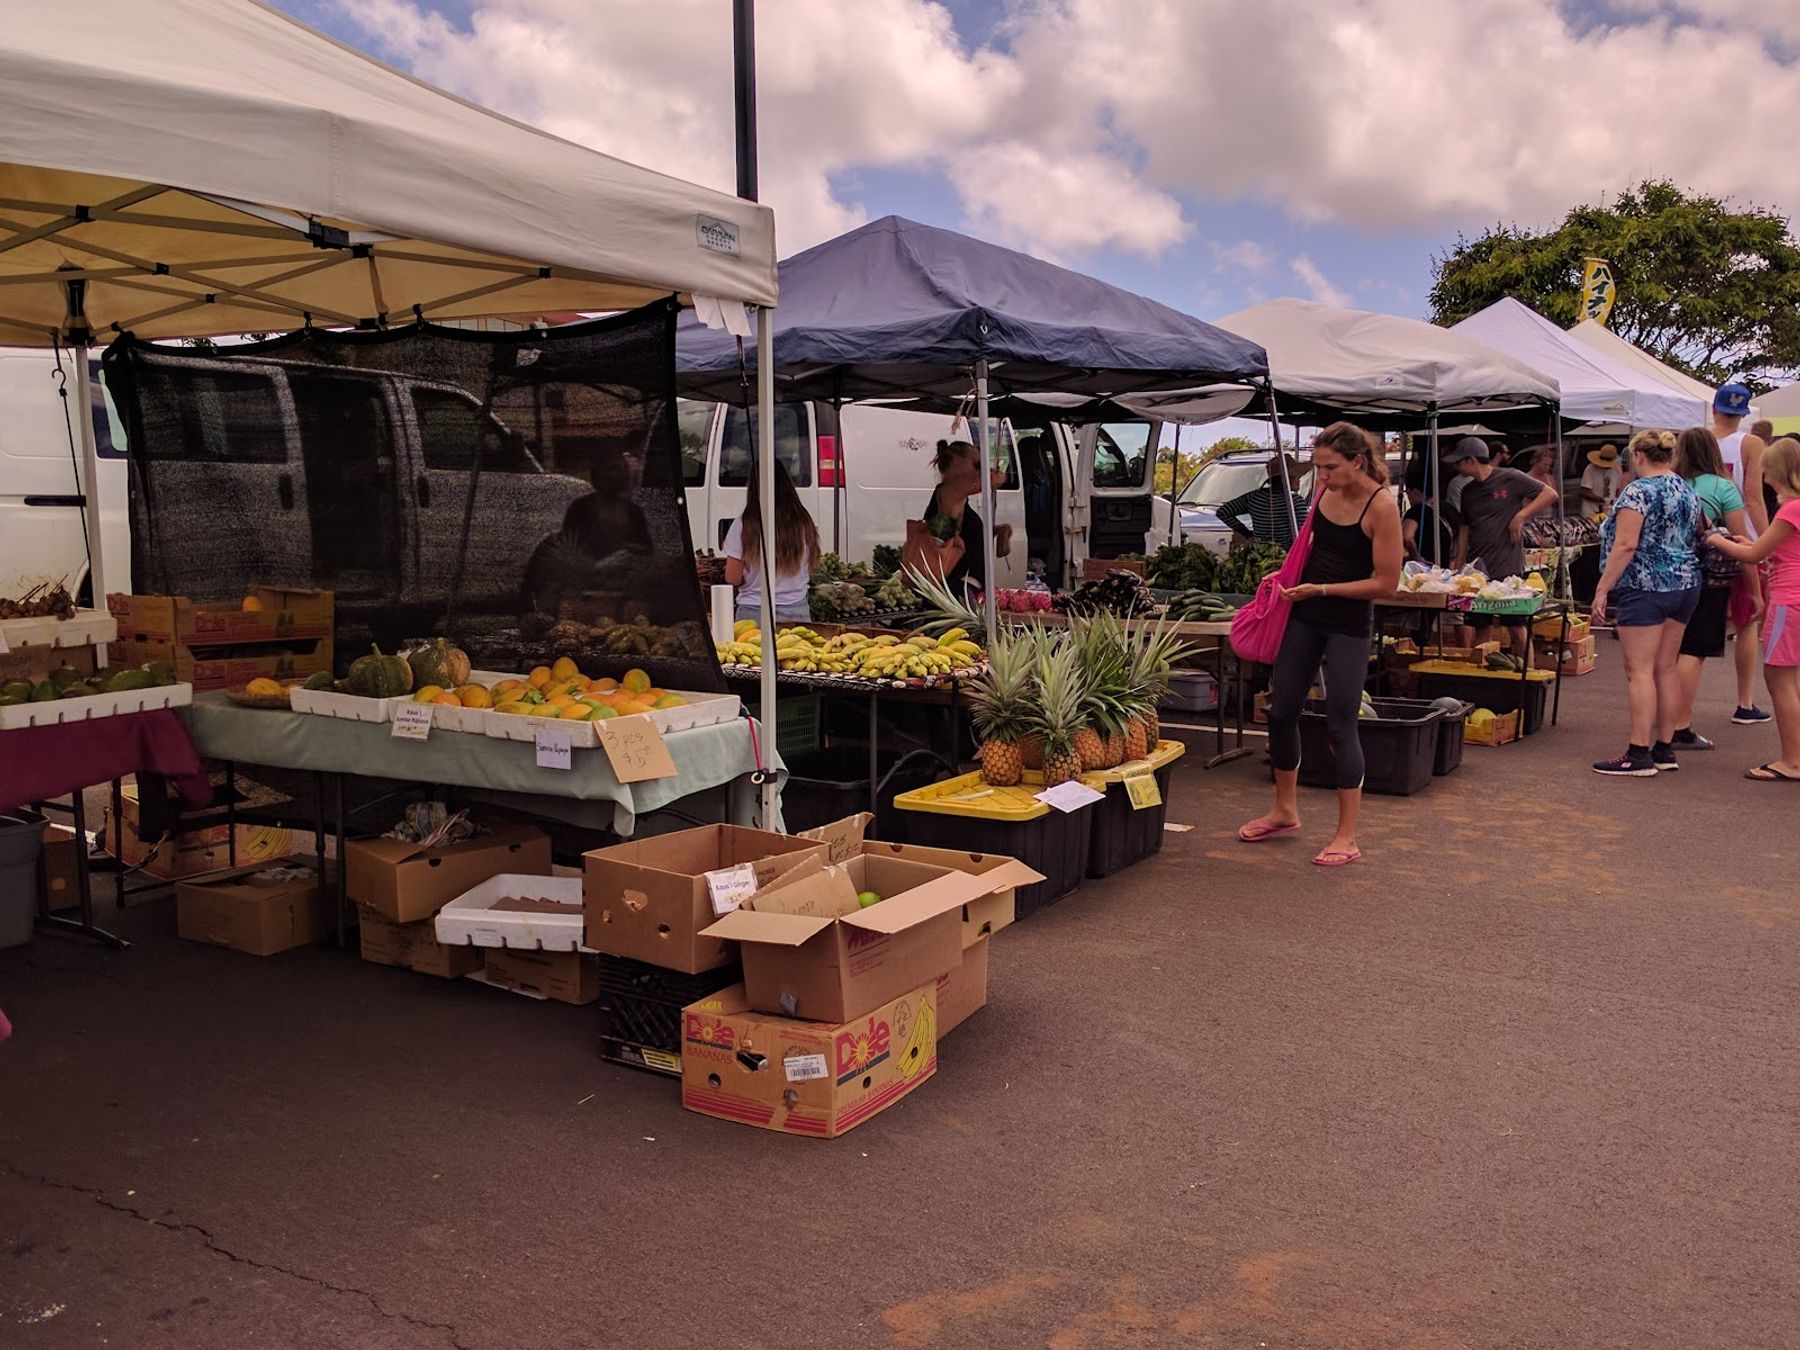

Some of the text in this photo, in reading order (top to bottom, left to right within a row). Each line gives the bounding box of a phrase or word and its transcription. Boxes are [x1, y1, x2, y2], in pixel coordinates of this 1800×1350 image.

[195, 616, 225, 632] Dole
[194, 663, 224, 680] Dole
[605, 731, 619, 750] 3
[686, 1013, 736, 1046] Dole
[686, 1047, 733, 1065] BANANAS
[836, 1016, 890, 1078] Dole
